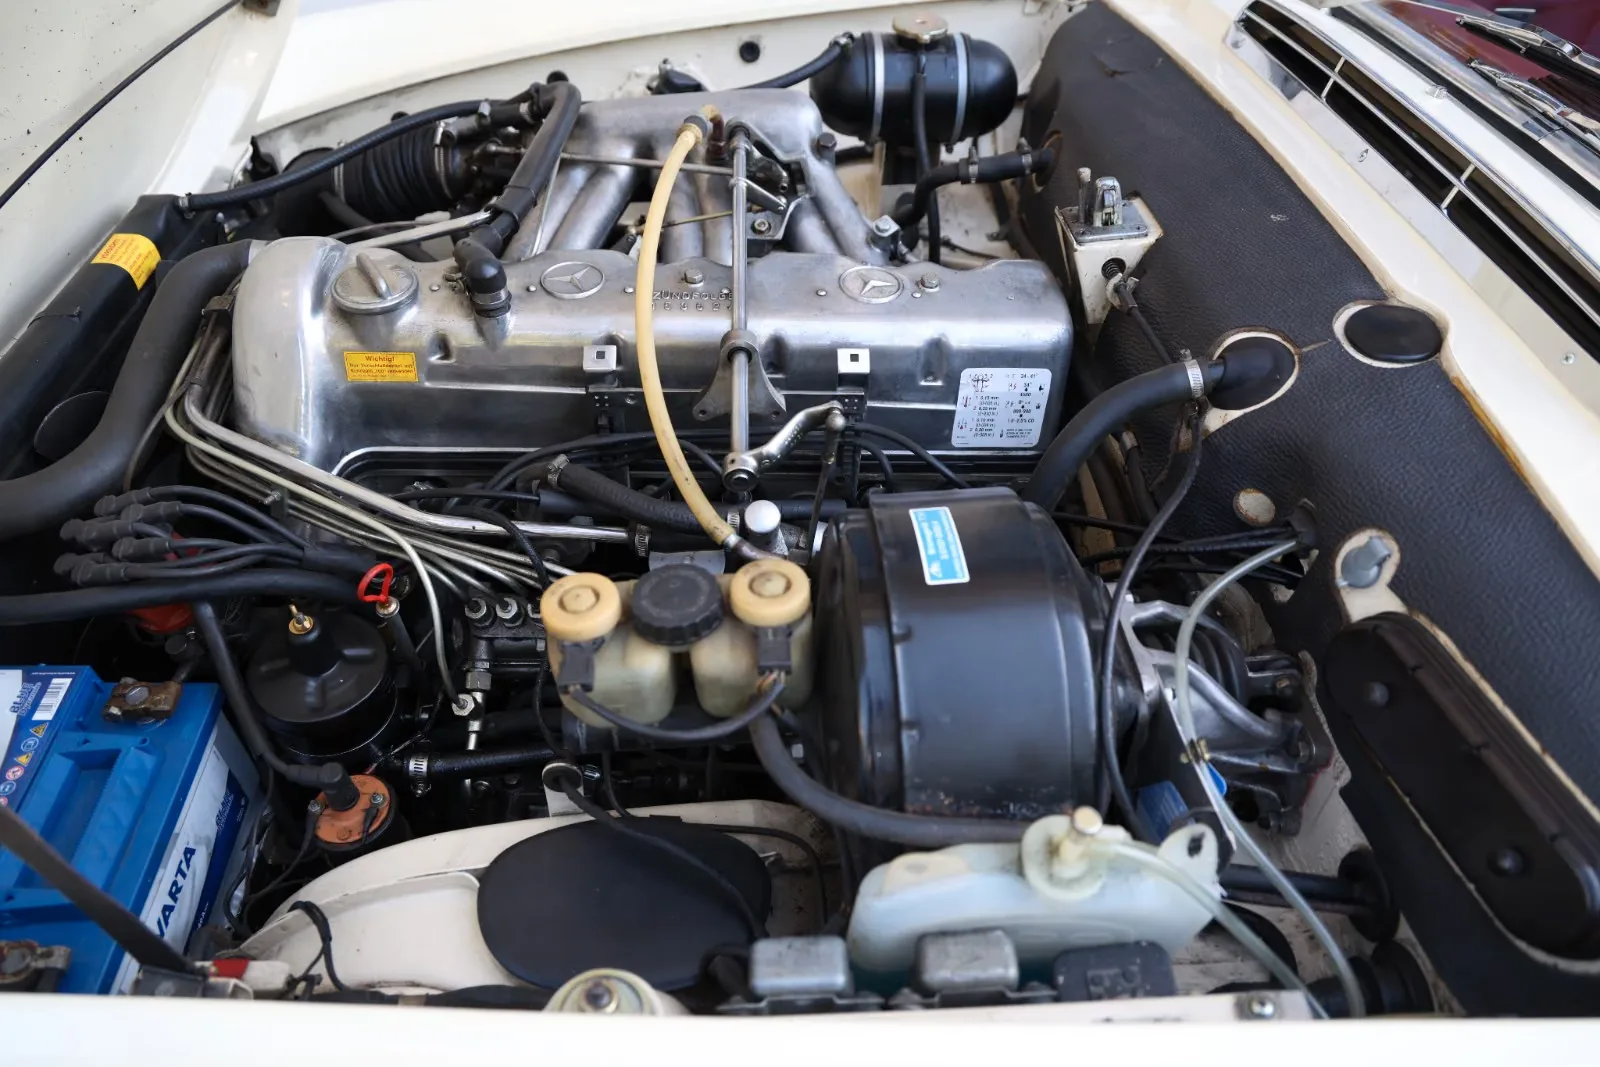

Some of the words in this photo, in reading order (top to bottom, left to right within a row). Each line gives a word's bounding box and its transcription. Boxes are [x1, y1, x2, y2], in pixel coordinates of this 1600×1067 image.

[365, 355, 395, 363] Wichtig!
[9, 682, 34, 714] BLUE
[156, 846, 197, 940] VARTA
